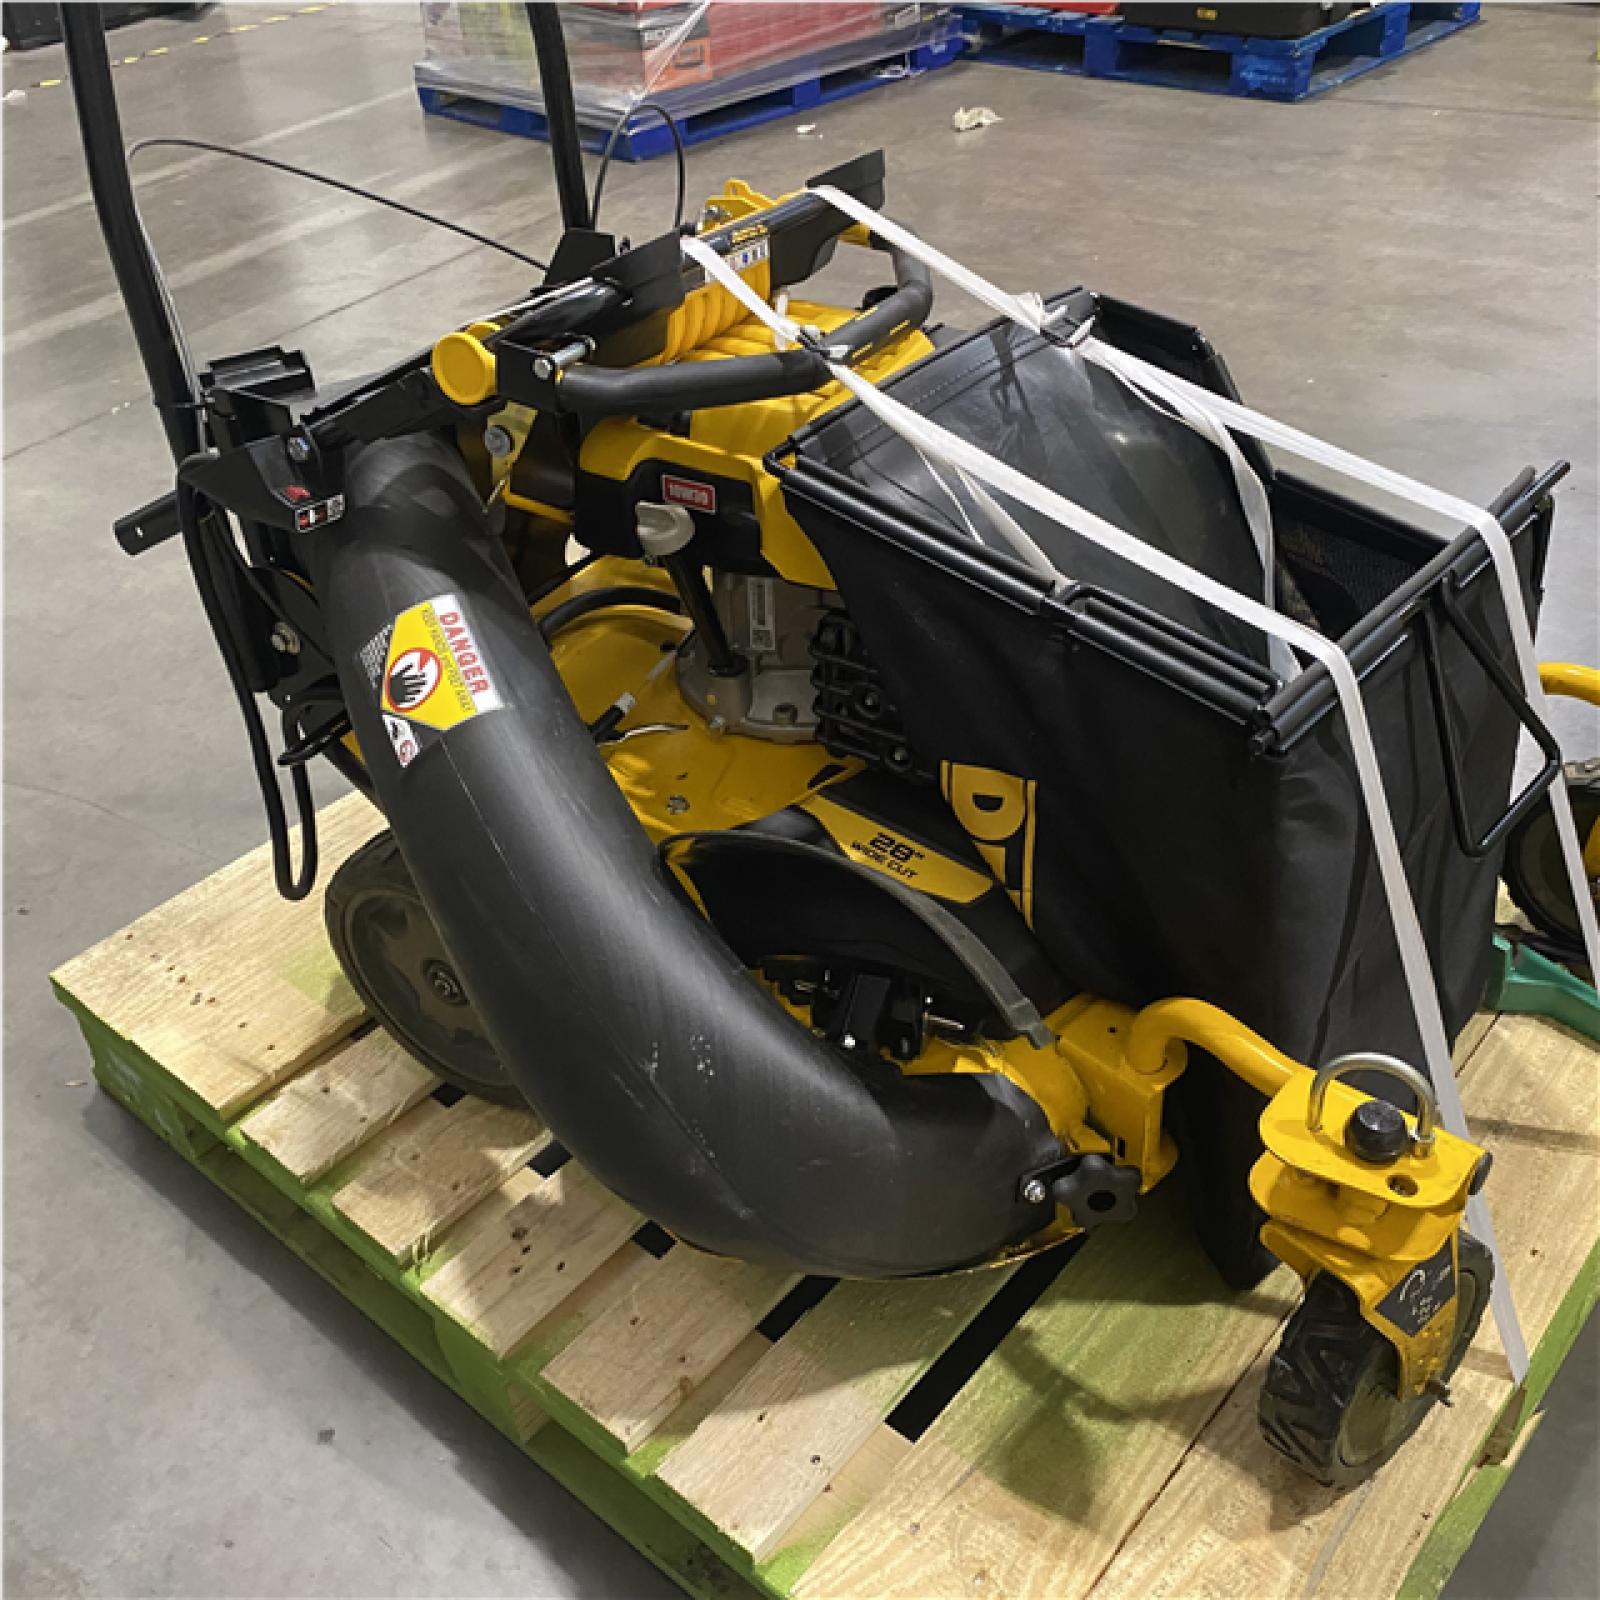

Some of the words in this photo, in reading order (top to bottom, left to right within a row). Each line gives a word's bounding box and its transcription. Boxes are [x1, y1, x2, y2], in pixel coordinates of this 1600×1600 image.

[439, 610, 490, 695] DANGER
[850, 840, 887, 864] WIDE
[886, 859, 918, 879] CUT
